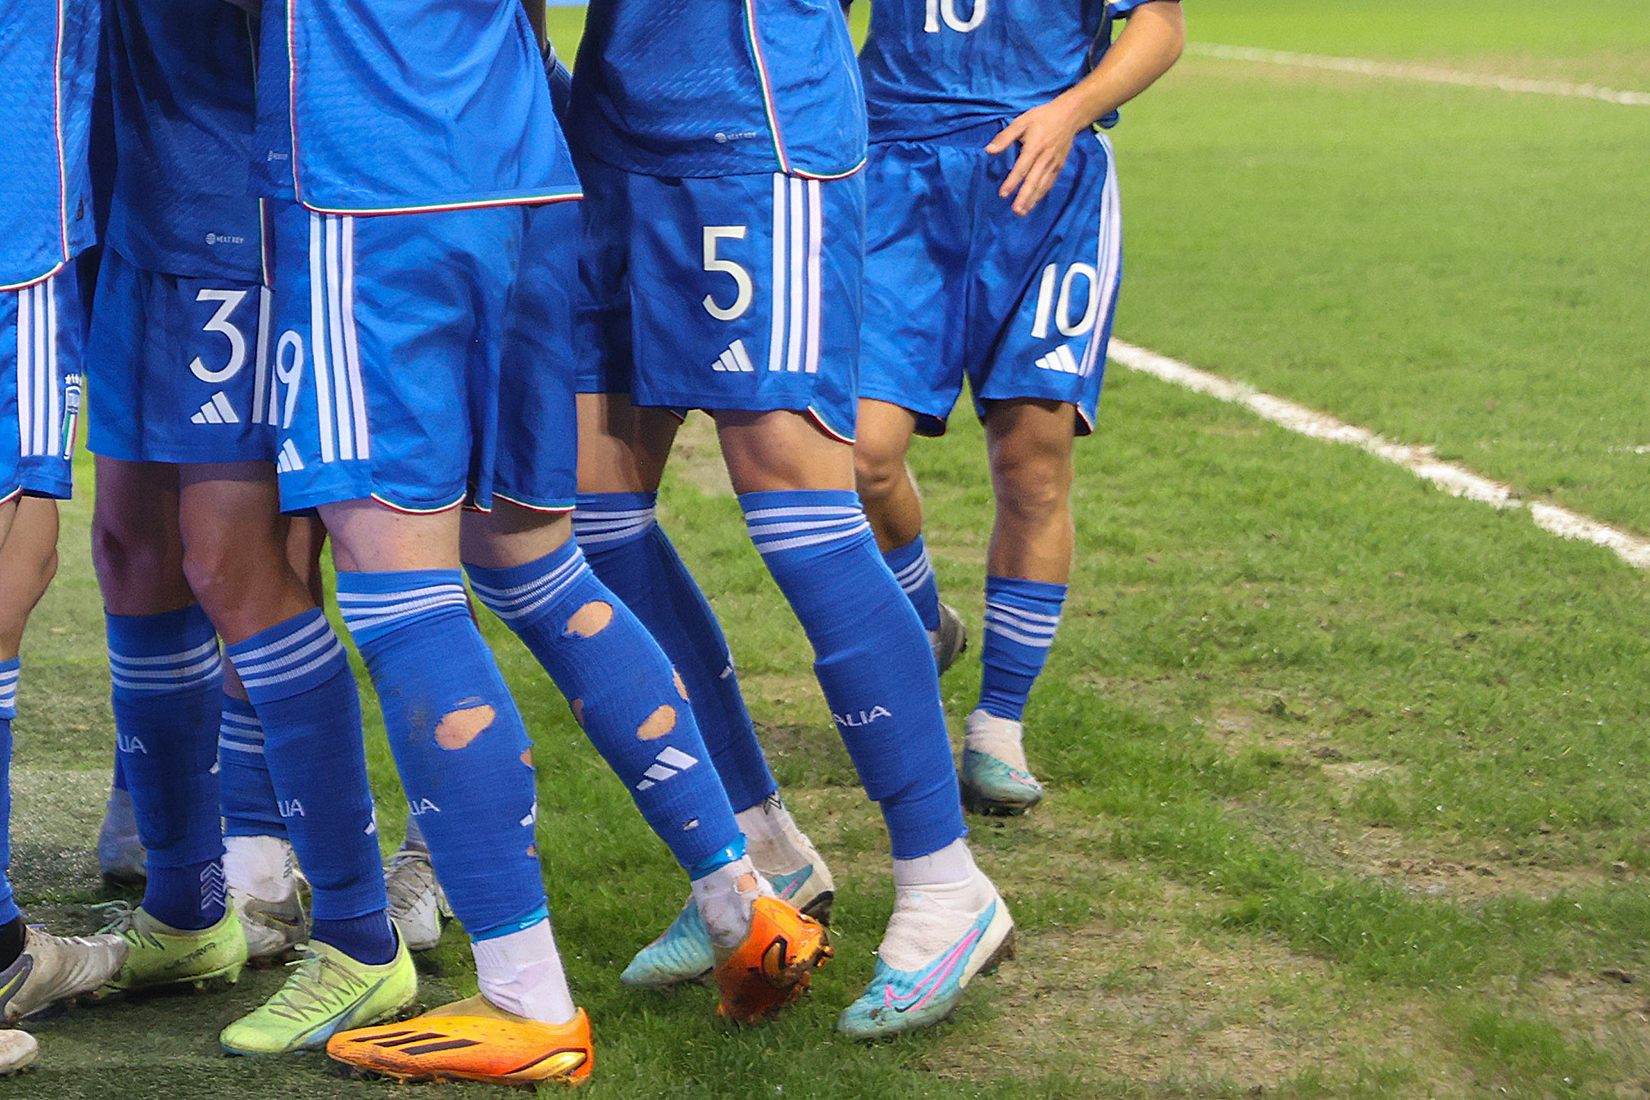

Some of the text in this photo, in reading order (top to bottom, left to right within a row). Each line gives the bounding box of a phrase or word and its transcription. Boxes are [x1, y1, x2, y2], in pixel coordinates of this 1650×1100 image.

[702, 226, 753, 321] 5
[1031, 262, 1097, 339] 10
[189, 289, 247, 383] 3
[276, 330, 304, 429] 9
